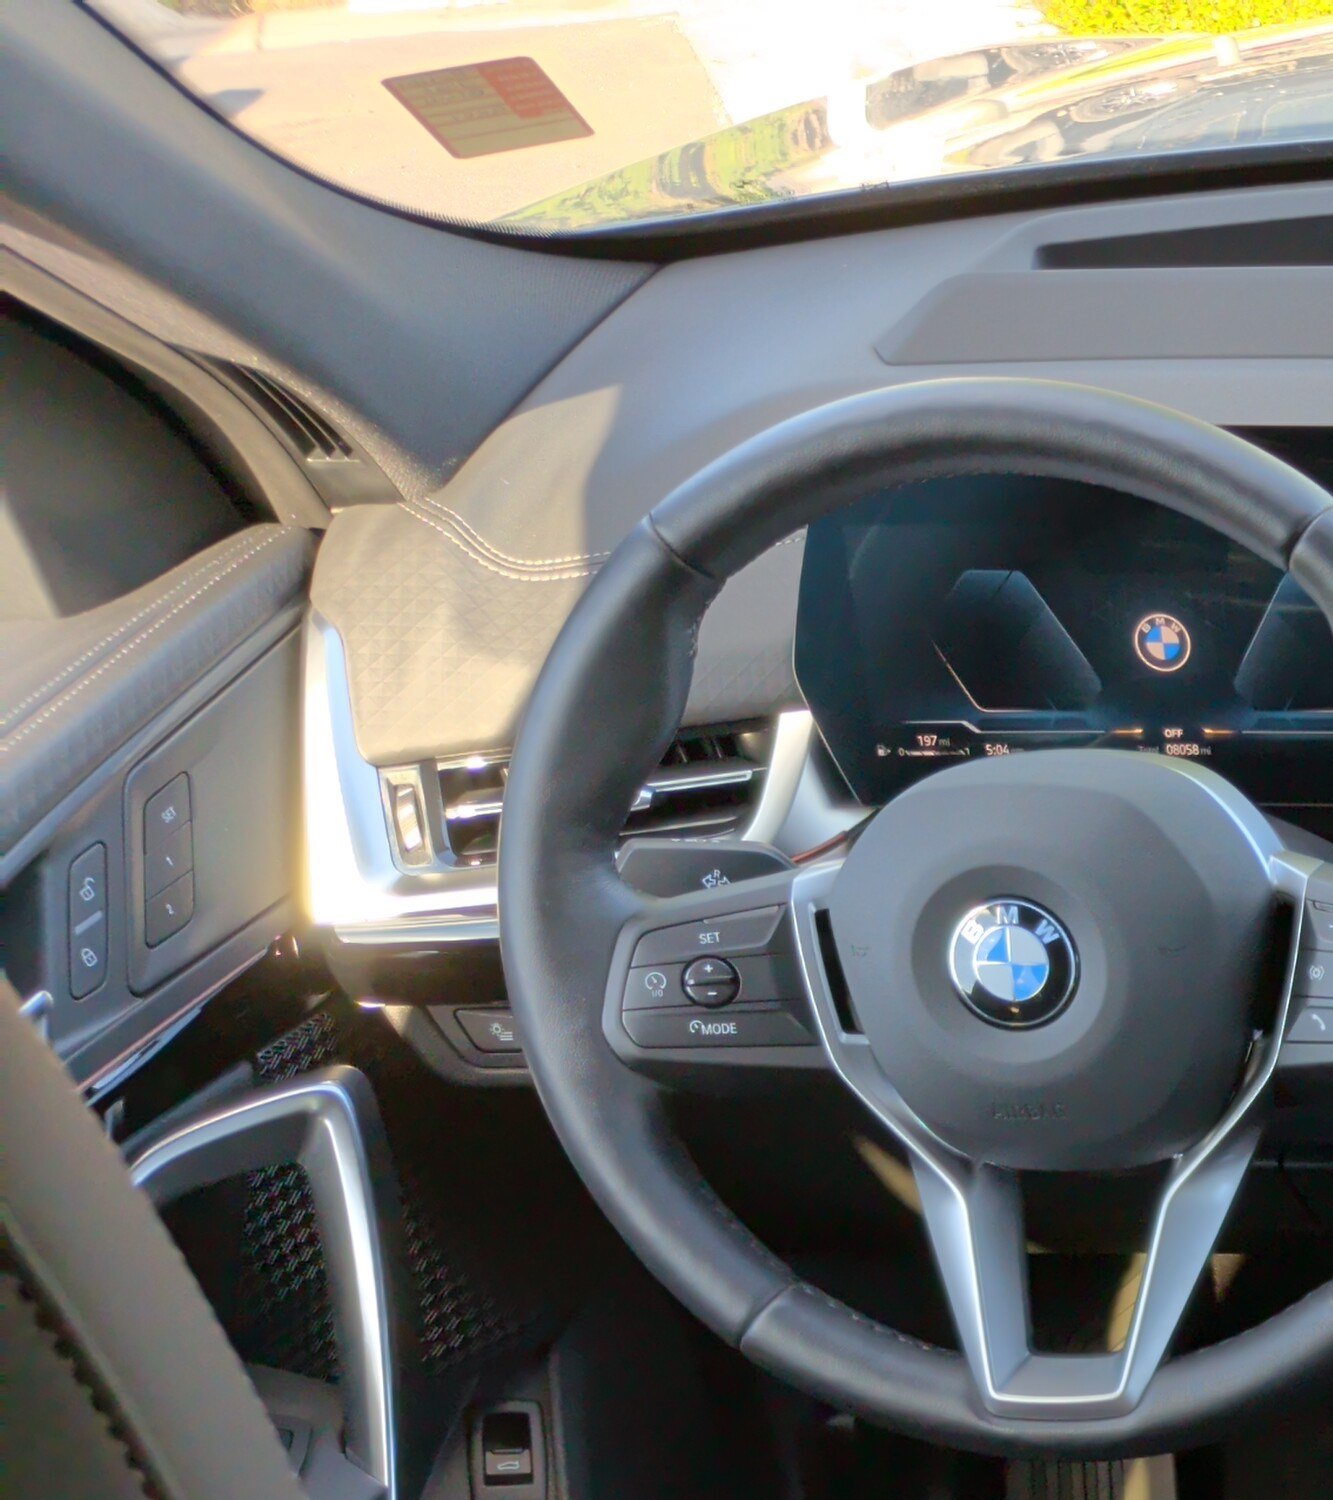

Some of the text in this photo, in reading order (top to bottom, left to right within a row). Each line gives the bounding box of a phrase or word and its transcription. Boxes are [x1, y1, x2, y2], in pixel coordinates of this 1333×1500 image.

[1141, 617, 1182, 634] BMW
[1164, 728, 1184, 739] OFF
[915, 735, 938, 747] 197
[984, 744, 1010, 756] 5:04
[1166, 744, 1200, 756] 08058
[960, 904, 1060, 945] BMW
[698, 931, 721, 945] SET
[702, 1021, 739, 1036] MODE
